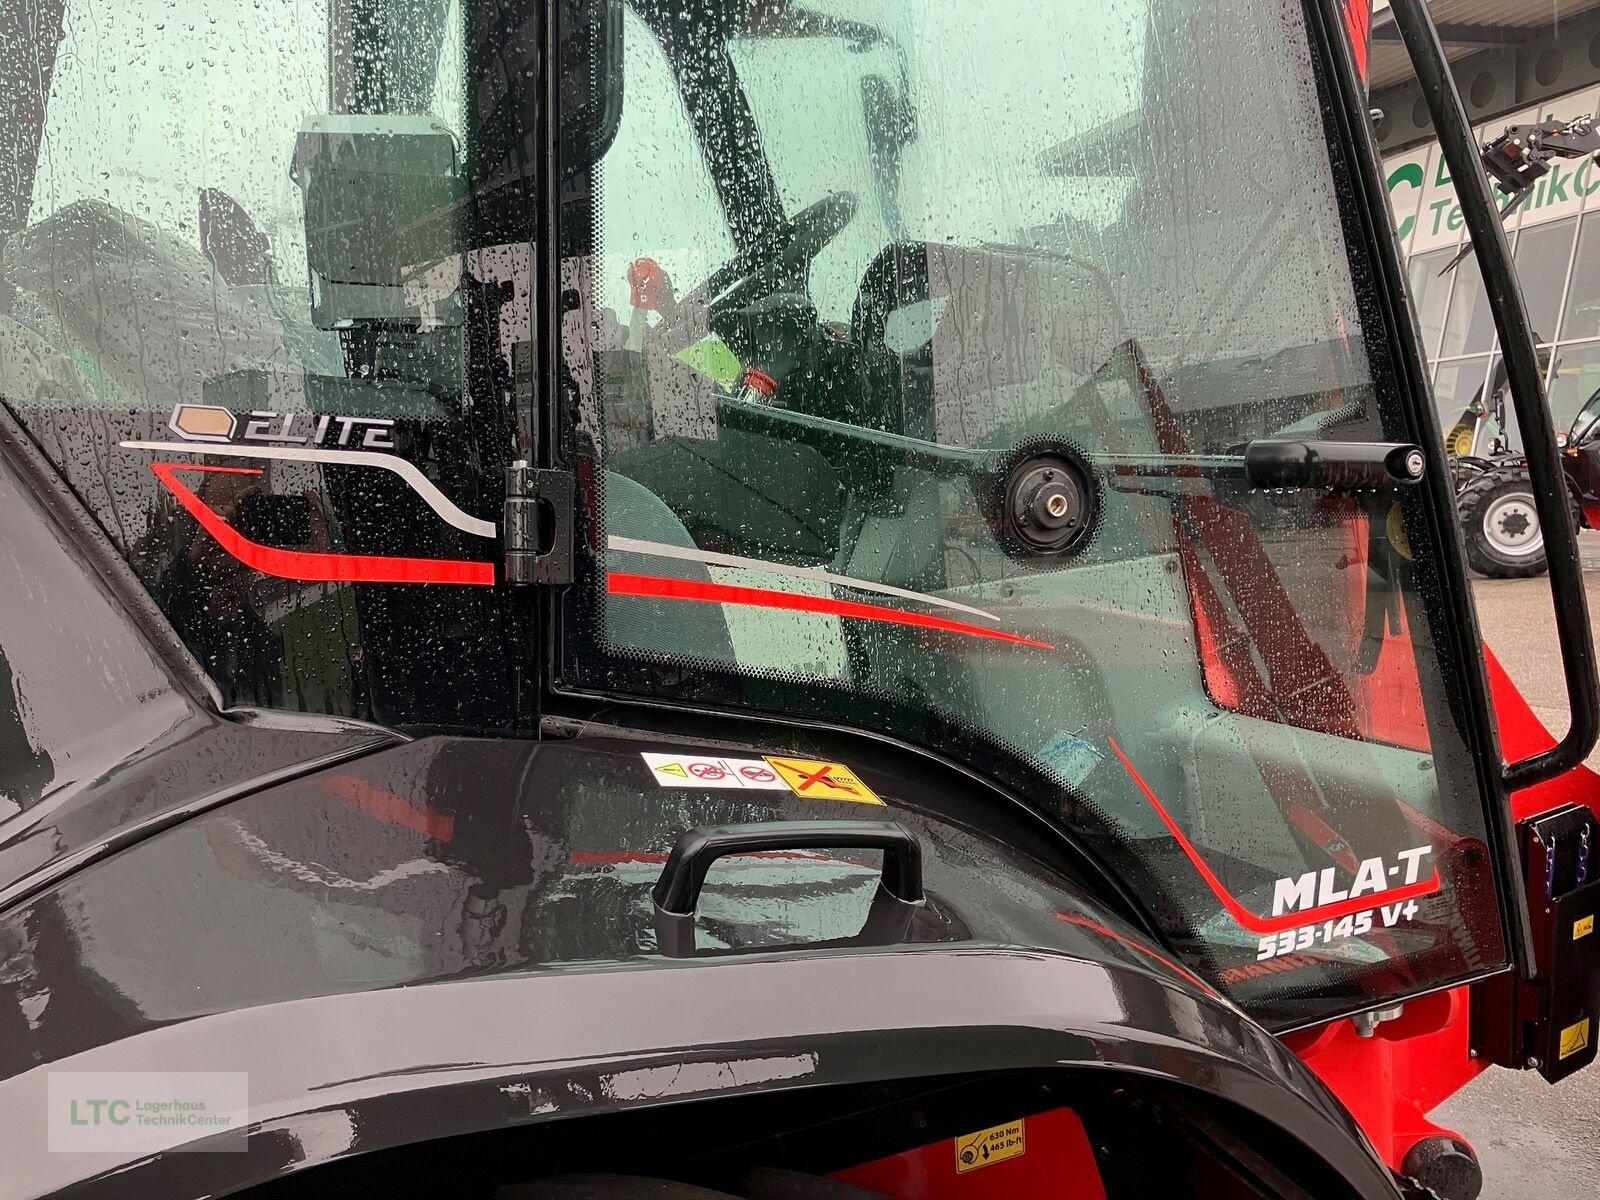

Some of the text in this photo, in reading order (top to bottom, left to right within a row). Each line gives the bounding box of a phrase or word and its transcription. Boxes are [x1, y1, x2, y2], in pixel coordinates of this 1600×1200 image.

[244, 410, 395, 448] ELITE
[1271, 845, 1432, 917] MLA-T
[1256, 910, 1373, 961] 533-145
[1381, 899, 1419, 928] V+
[989, 1127, 1020, 1141] 630 Nm
[989, 1136, 1023, 1152] 465 lb-ft
